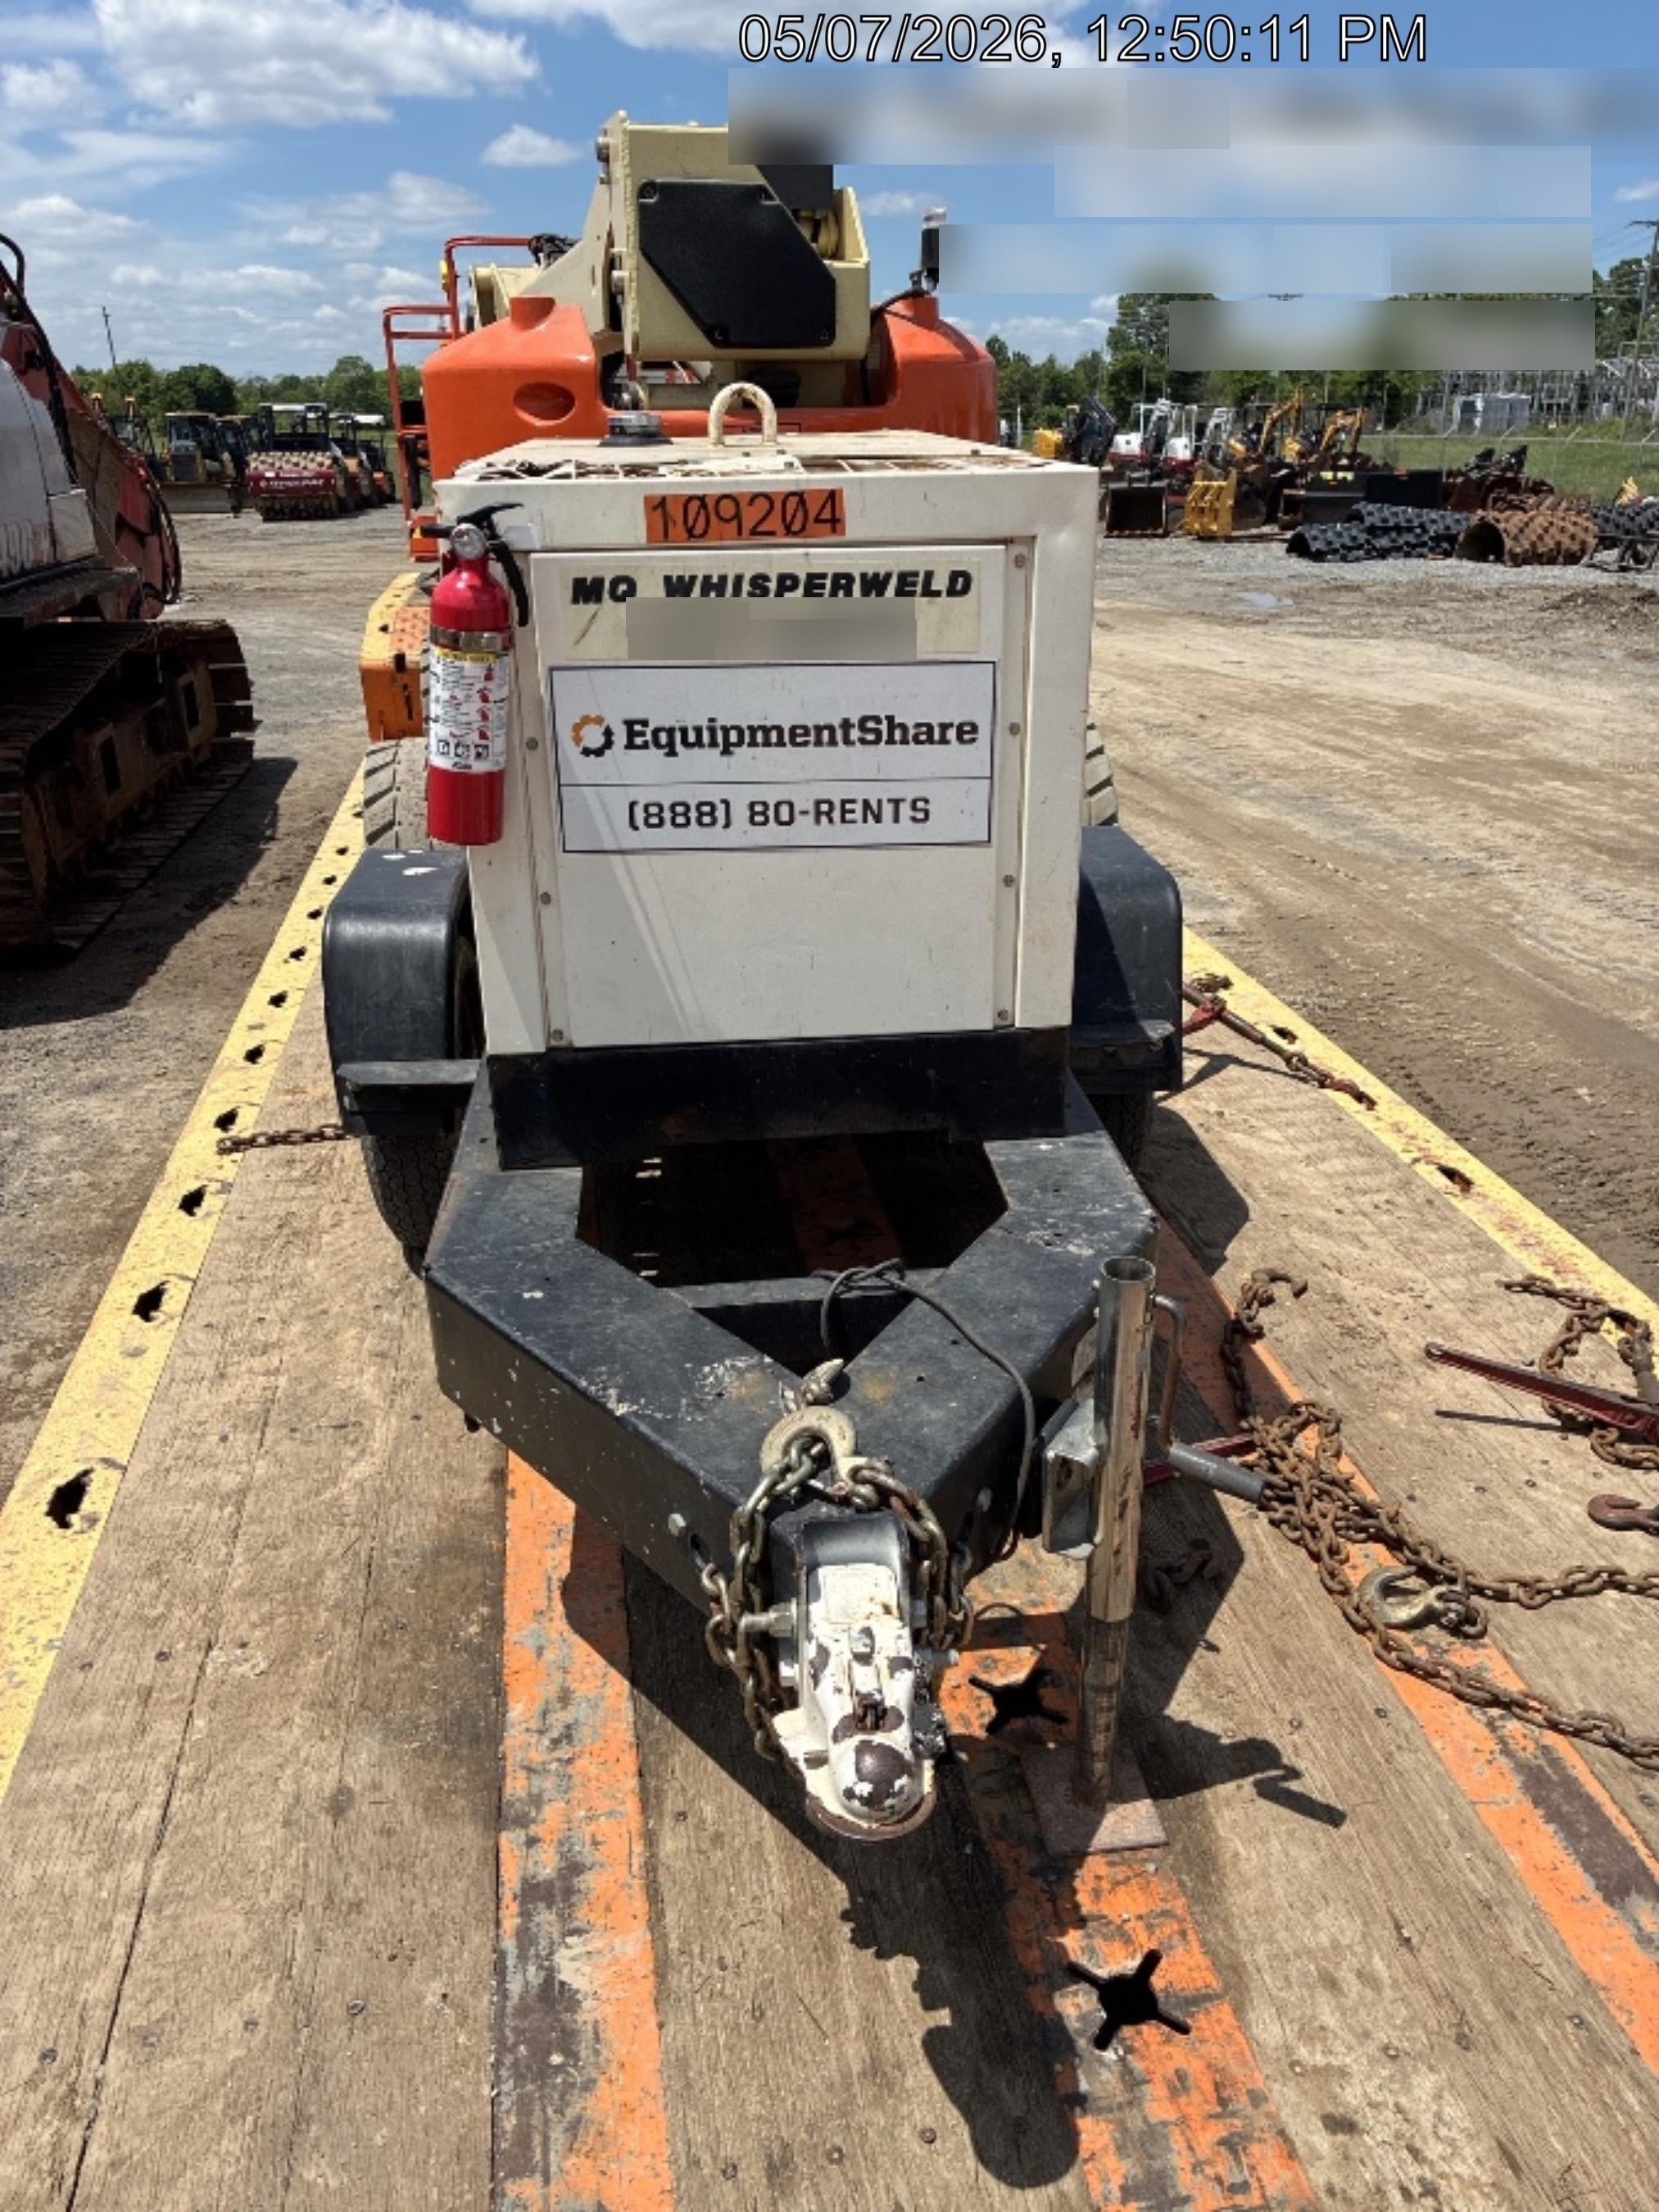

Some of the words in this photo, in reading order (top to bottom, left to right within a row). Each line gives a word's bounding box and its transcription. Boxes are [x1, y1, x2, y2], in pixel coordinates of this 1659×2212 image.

[651, 489, 841, 541] 109204
[571, 575, 637, 605] MQ
[663, 569, 973, 598] WHISPERWELD
[623, 714, 979, 756] EquipmentShare
[628, 800, 732, 831] (888)
[748, 797, 931, 826] 80-RENTS
